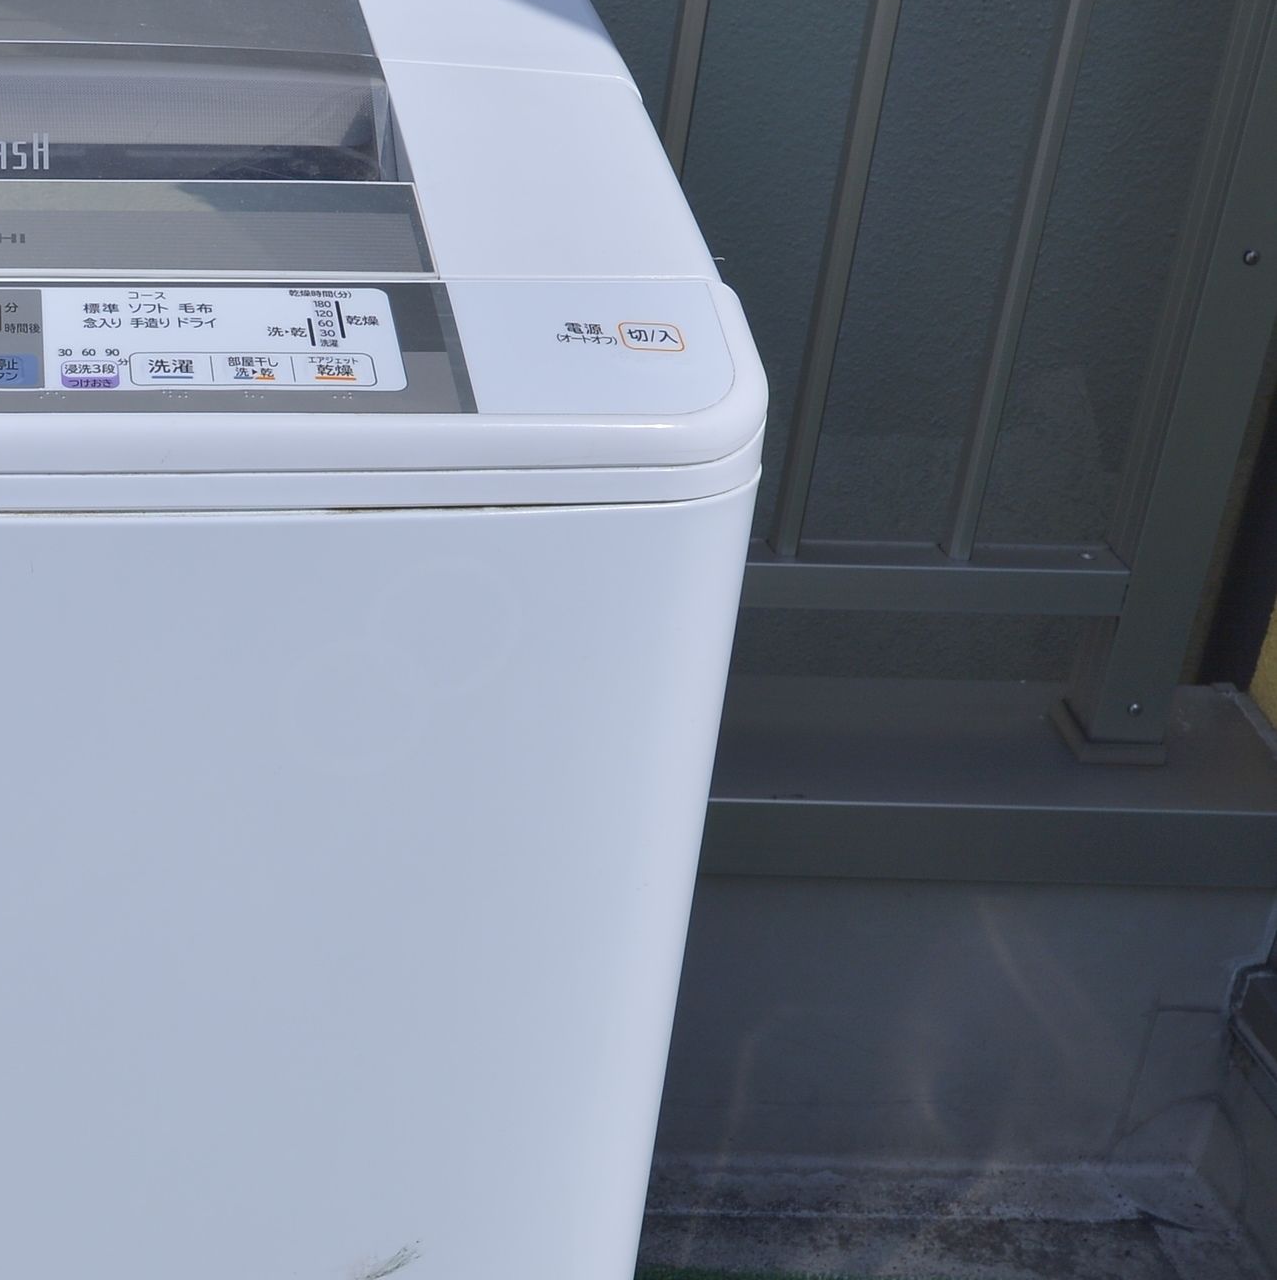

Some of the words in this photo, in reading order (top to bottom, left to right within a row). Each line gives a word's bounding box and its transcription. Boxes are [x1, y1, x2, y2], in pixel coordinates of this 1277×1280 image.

[128, 291, 166, 300] コース
[289, 289, 351, 298] 乾燥時間(分)
[5, 302, 18, 313] 分
[83, 302, 119, 314] 標準
[128, 303, 169, 314] ソフト
[179, 302, 213, 314] 毛布
[315, 310, 333, 318] 120
[83, 317, 122, 328] 念入り
[130, 317, 170, 328] 手造り
[178, 317, 216, 328] ドライ
[346, 315, 379, 326] 乾燥
[5, 323, 41, 333] 時間後
[320, 329, 335, 337] 30
[565, 322, 603, 334] 電源
[556, 333, 617, 345] (オートオフ)
[627, 329, 678, 344] 切/入
[320, 339, 338, 348] 洗濯
[58, 348, 72, 357] 30
[82, 348, 96, 357] 60
[105, 348, 120, 357] 90
[148, 358, 194, 373] 洗濯
[228, 356, 278, 367] 部屋干し
[65, 363, 115, 375] 浸洗3段
[316, 365, 354, 376] 乾燥
[69, 378, 111, 387] つけおき
